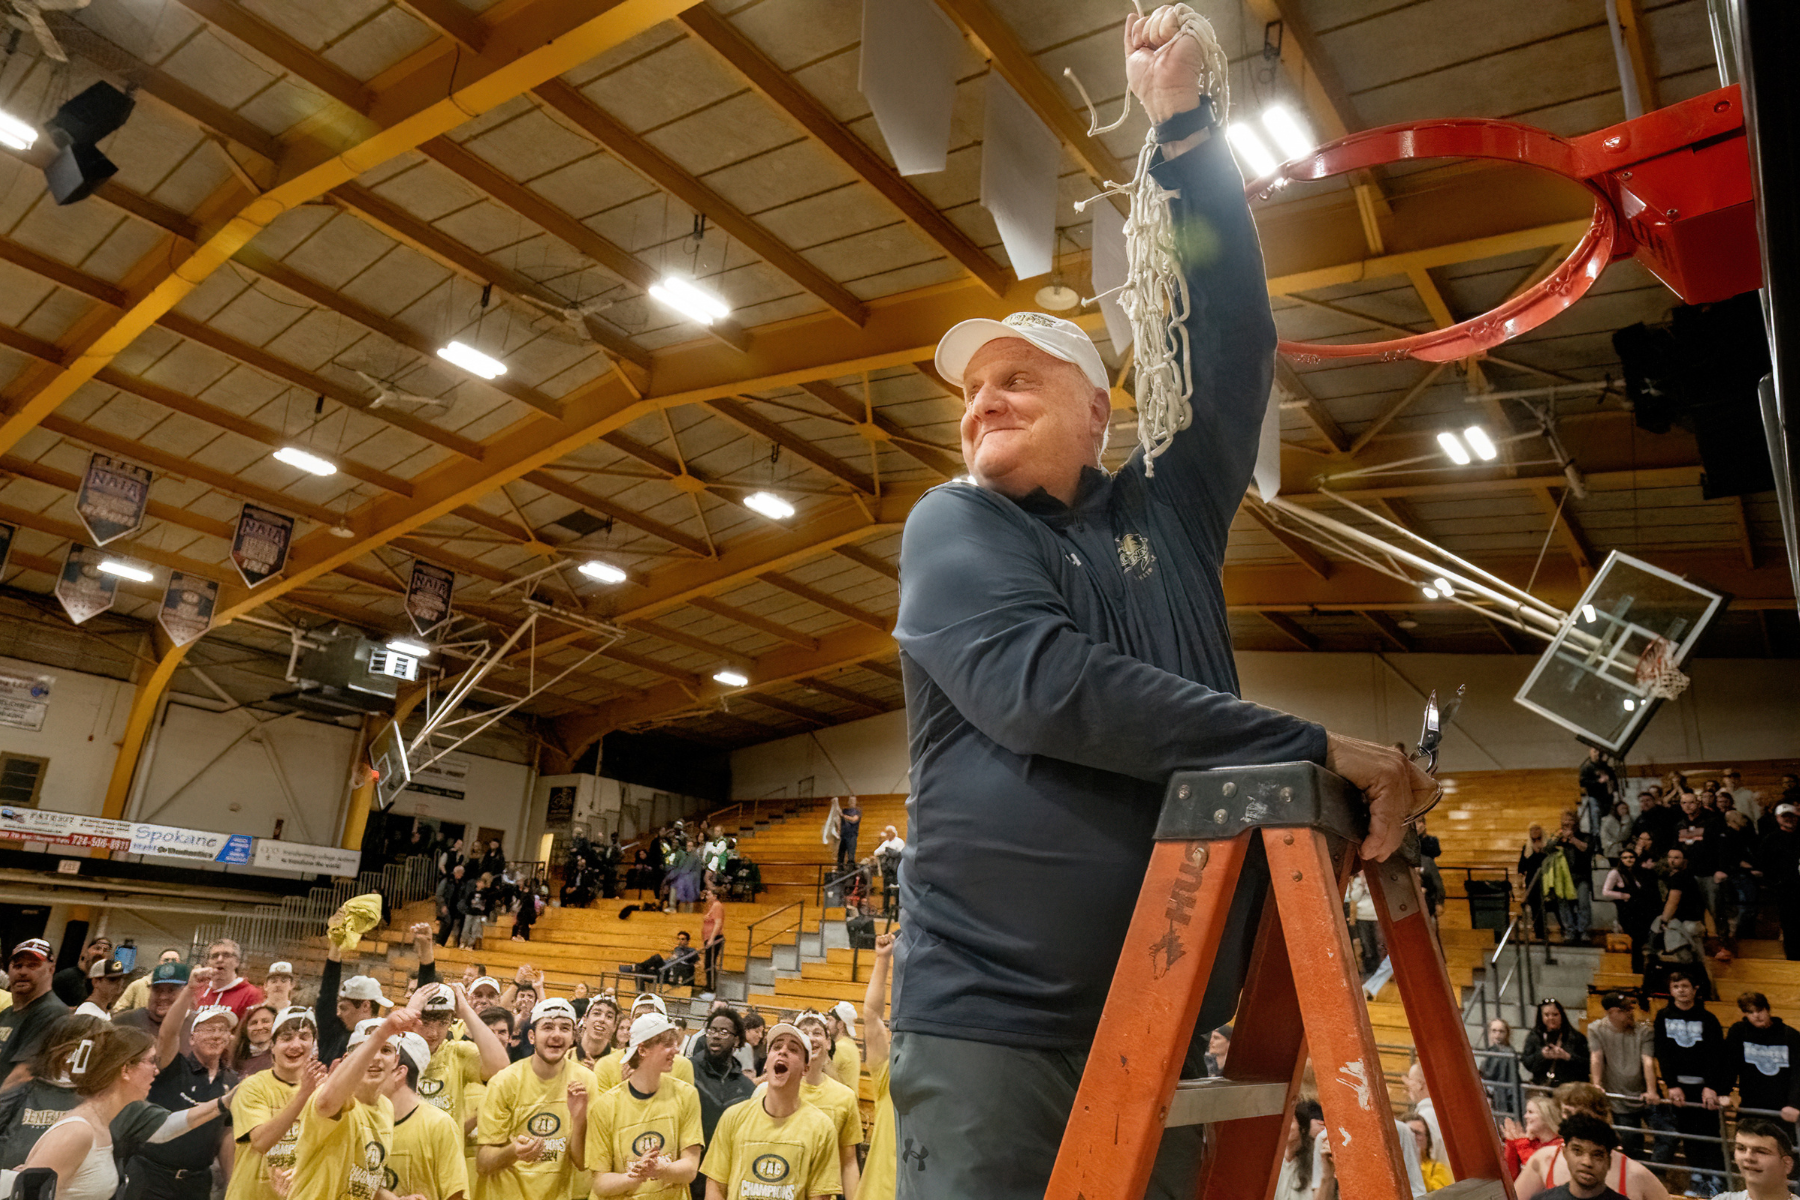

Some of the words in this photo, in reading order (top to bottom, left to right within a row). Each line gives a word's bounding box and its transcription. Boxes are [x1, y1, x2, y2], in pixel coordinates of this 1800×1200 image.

[89, 470, 139, 500] NAIA
[242, 519, 285, 545] NAIA
[413, 573, 448, 598] NAIA
[760, 1161, 782, 1176] PAC
[741, 1180, 795, 1200] CHAMPIONS
